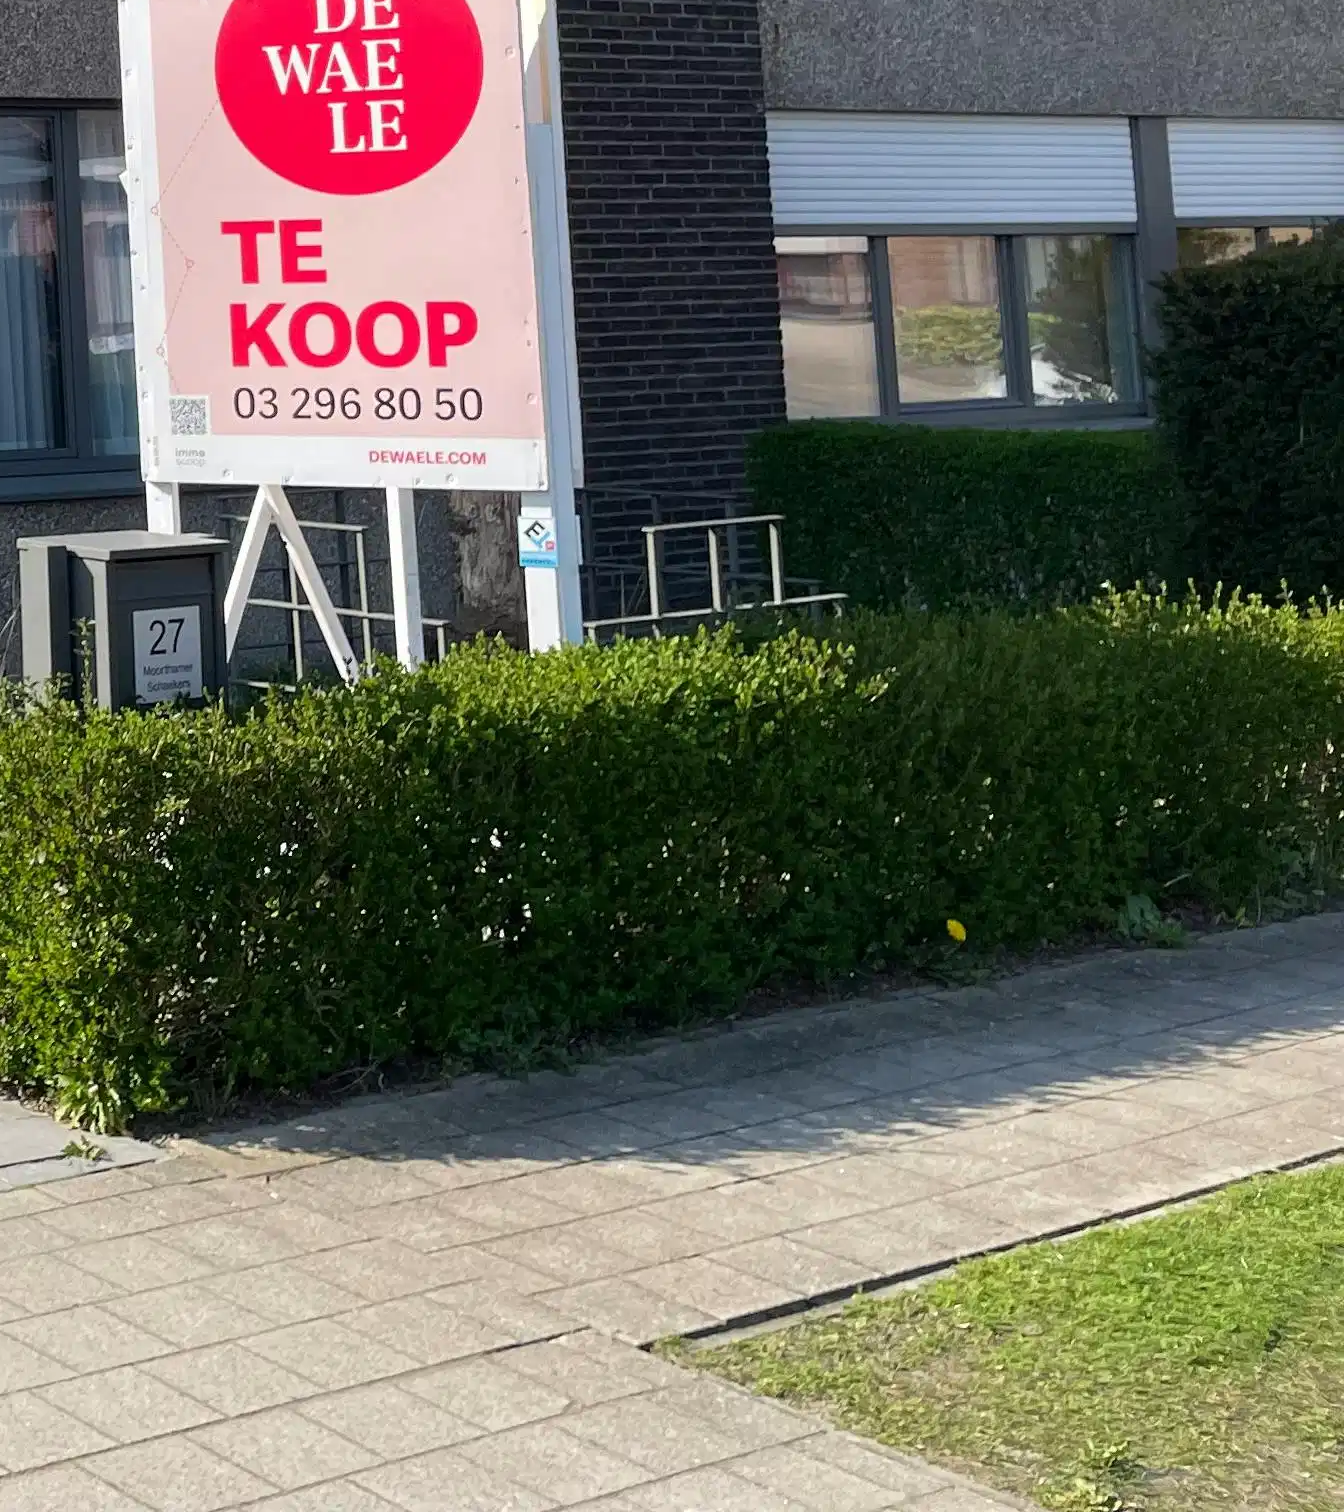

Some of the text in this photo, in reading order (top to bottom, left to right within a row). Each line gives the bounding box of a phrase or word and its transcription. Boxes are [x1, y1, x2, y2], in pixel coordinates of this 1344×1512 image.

[262, 38, 404, 95] WAE
[328, 99, 408, 153] LE
[220, 219, 327, 284] TE
[229, 300, 479, 369] KOOP
[233, 387, 484, 421] 03 296 80 50
[368, 449, 487, 466] DEWAELE.COM
[148, 617, 186, 656] 27
